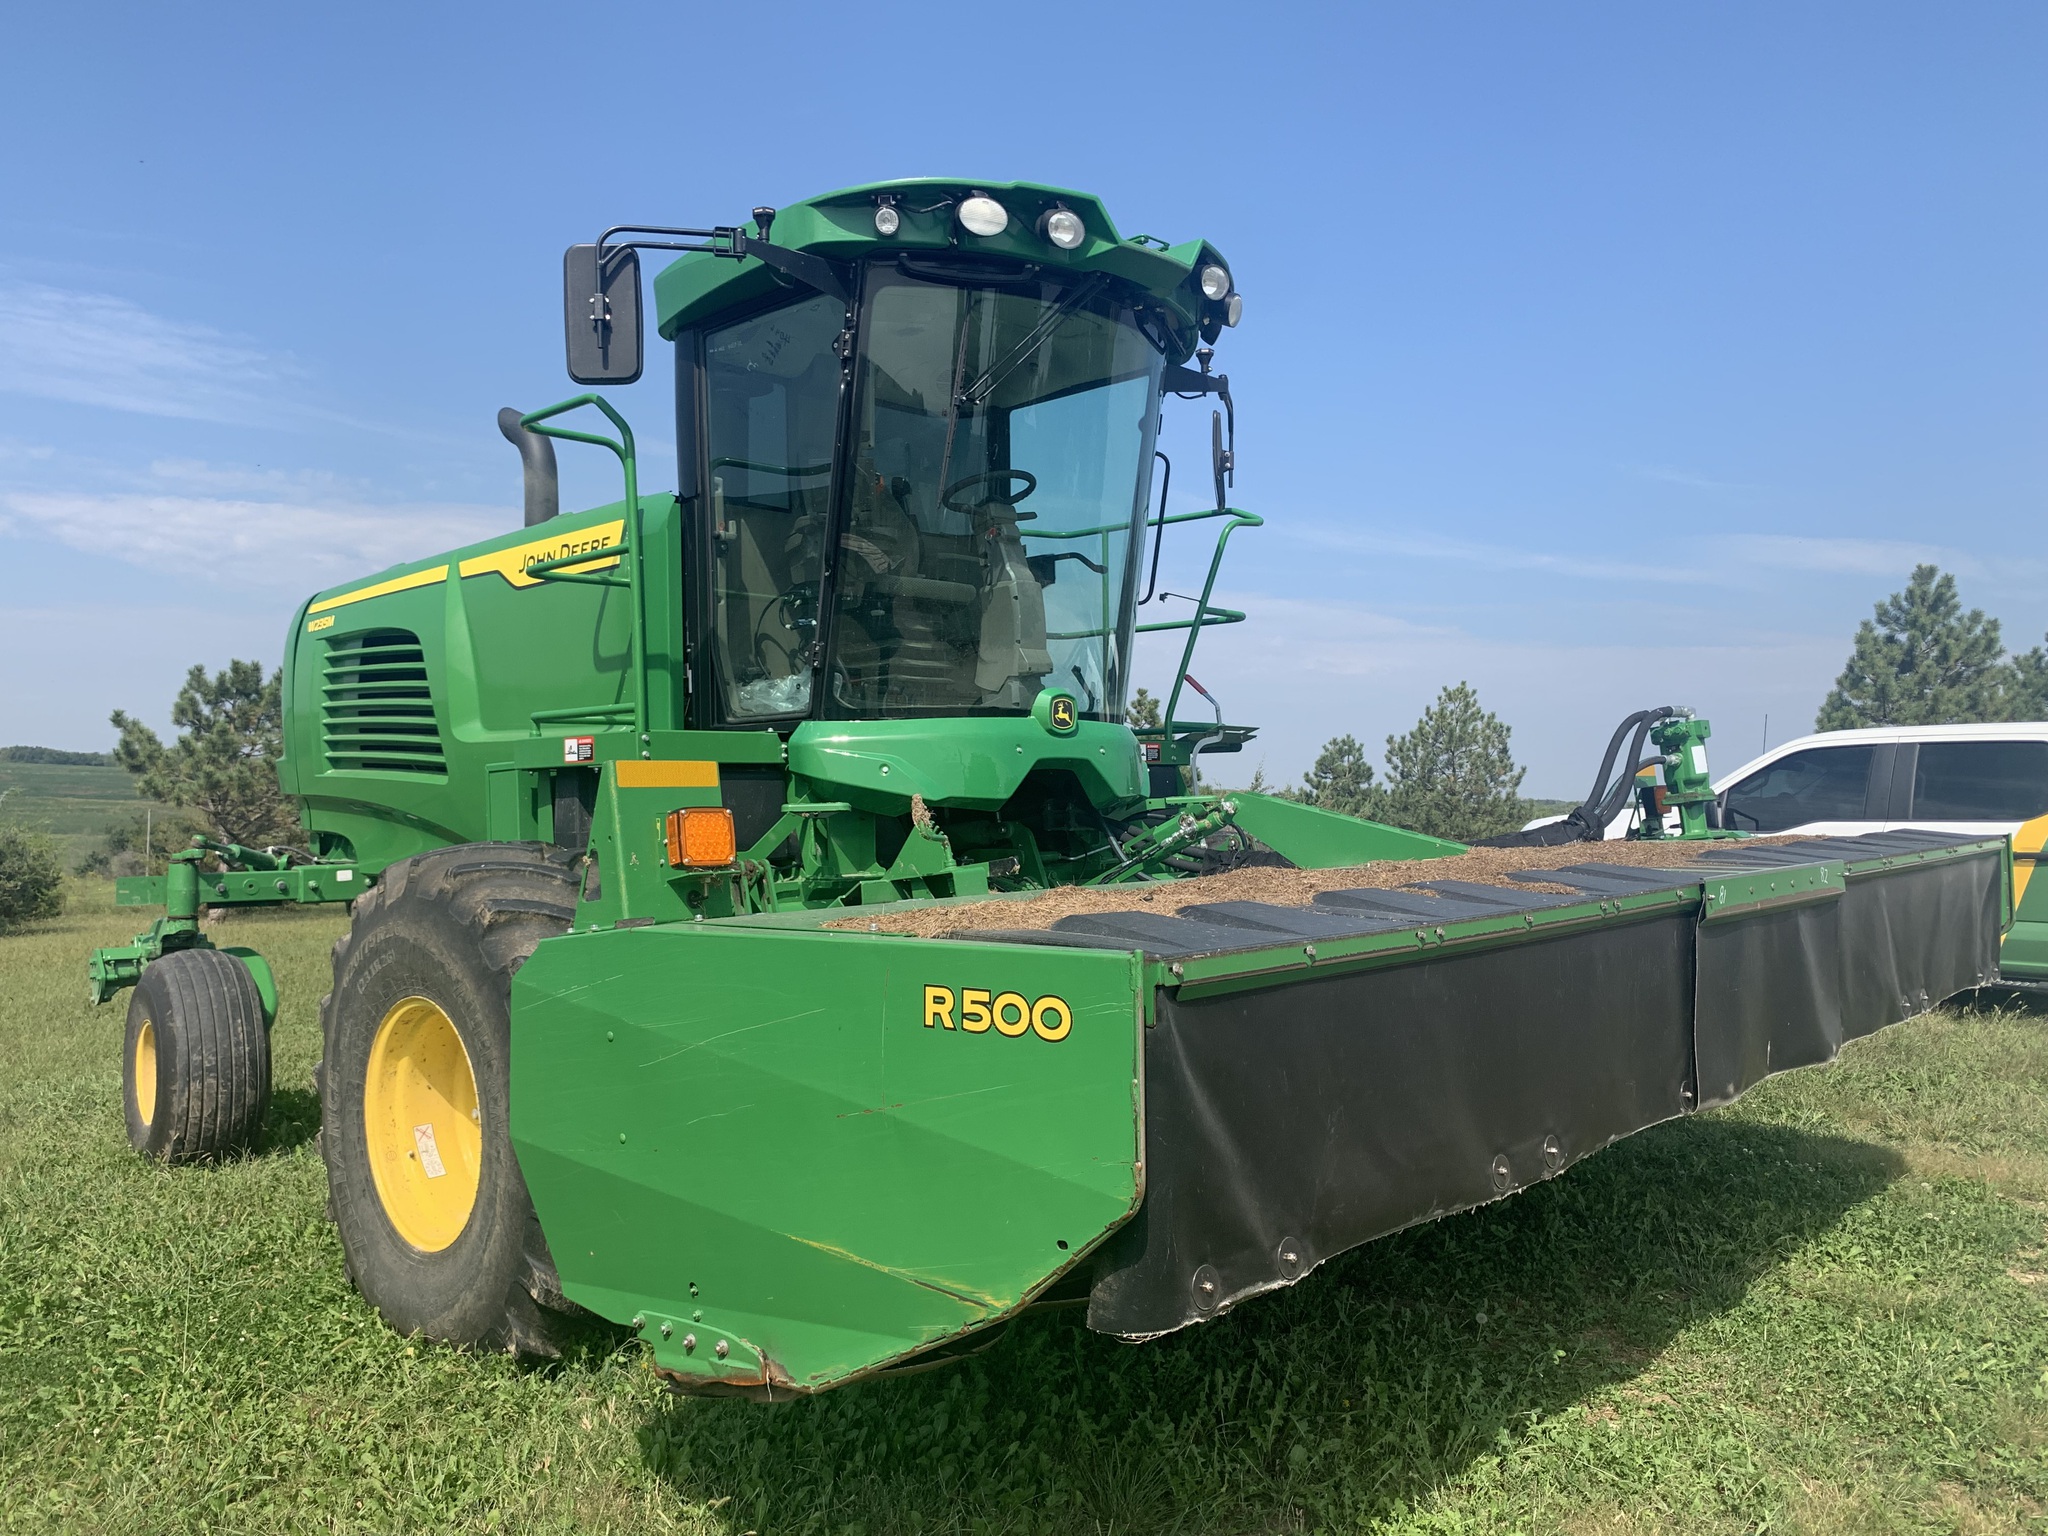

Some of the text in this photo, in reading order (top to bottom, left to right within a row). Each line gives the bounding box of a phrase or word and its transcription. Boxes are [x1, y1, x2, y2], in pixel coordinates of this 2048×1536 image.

[518, 536, 611, 574] JOHN DEERE
[1819, 866, 1829, 885] 82
[923, 984, 1074, 1044] R500
